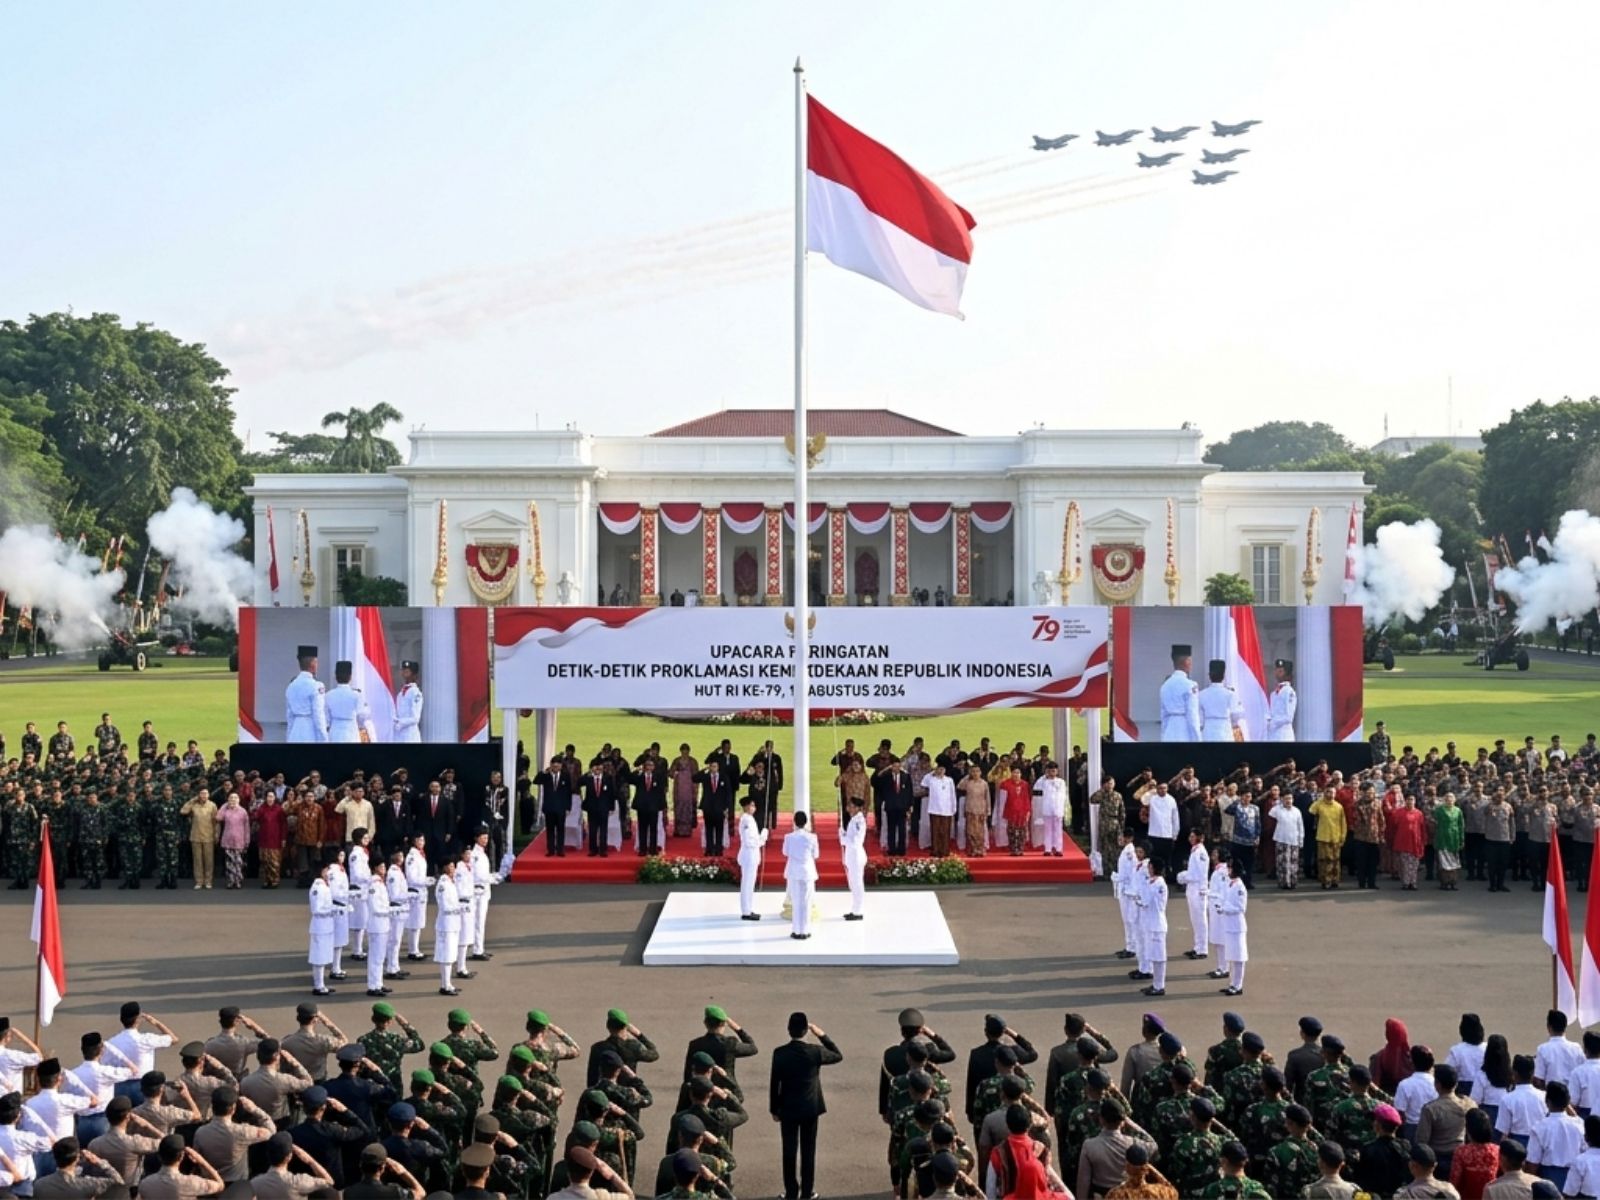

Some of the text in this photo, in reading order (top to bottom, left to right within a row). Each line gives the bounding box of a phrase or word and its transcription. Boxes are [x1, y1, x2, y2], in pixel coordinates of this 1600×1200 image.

[1032, 615, 1060, 642] 79
[710, 644, 889, 659] UPACARA PRINGATAN
[547, 663, 647, 678] DETIK-DETIK
[650, 663, 754, 678] PROKLAMASI
[883, 663, 962, 678] REPUBLIK
[966, 663, 1053, 678] INDONESIA
[694, 684, 722, 697] HUT
[725, 684, 739, 697] RI
[742, 684, 786, 699] KE-79,
